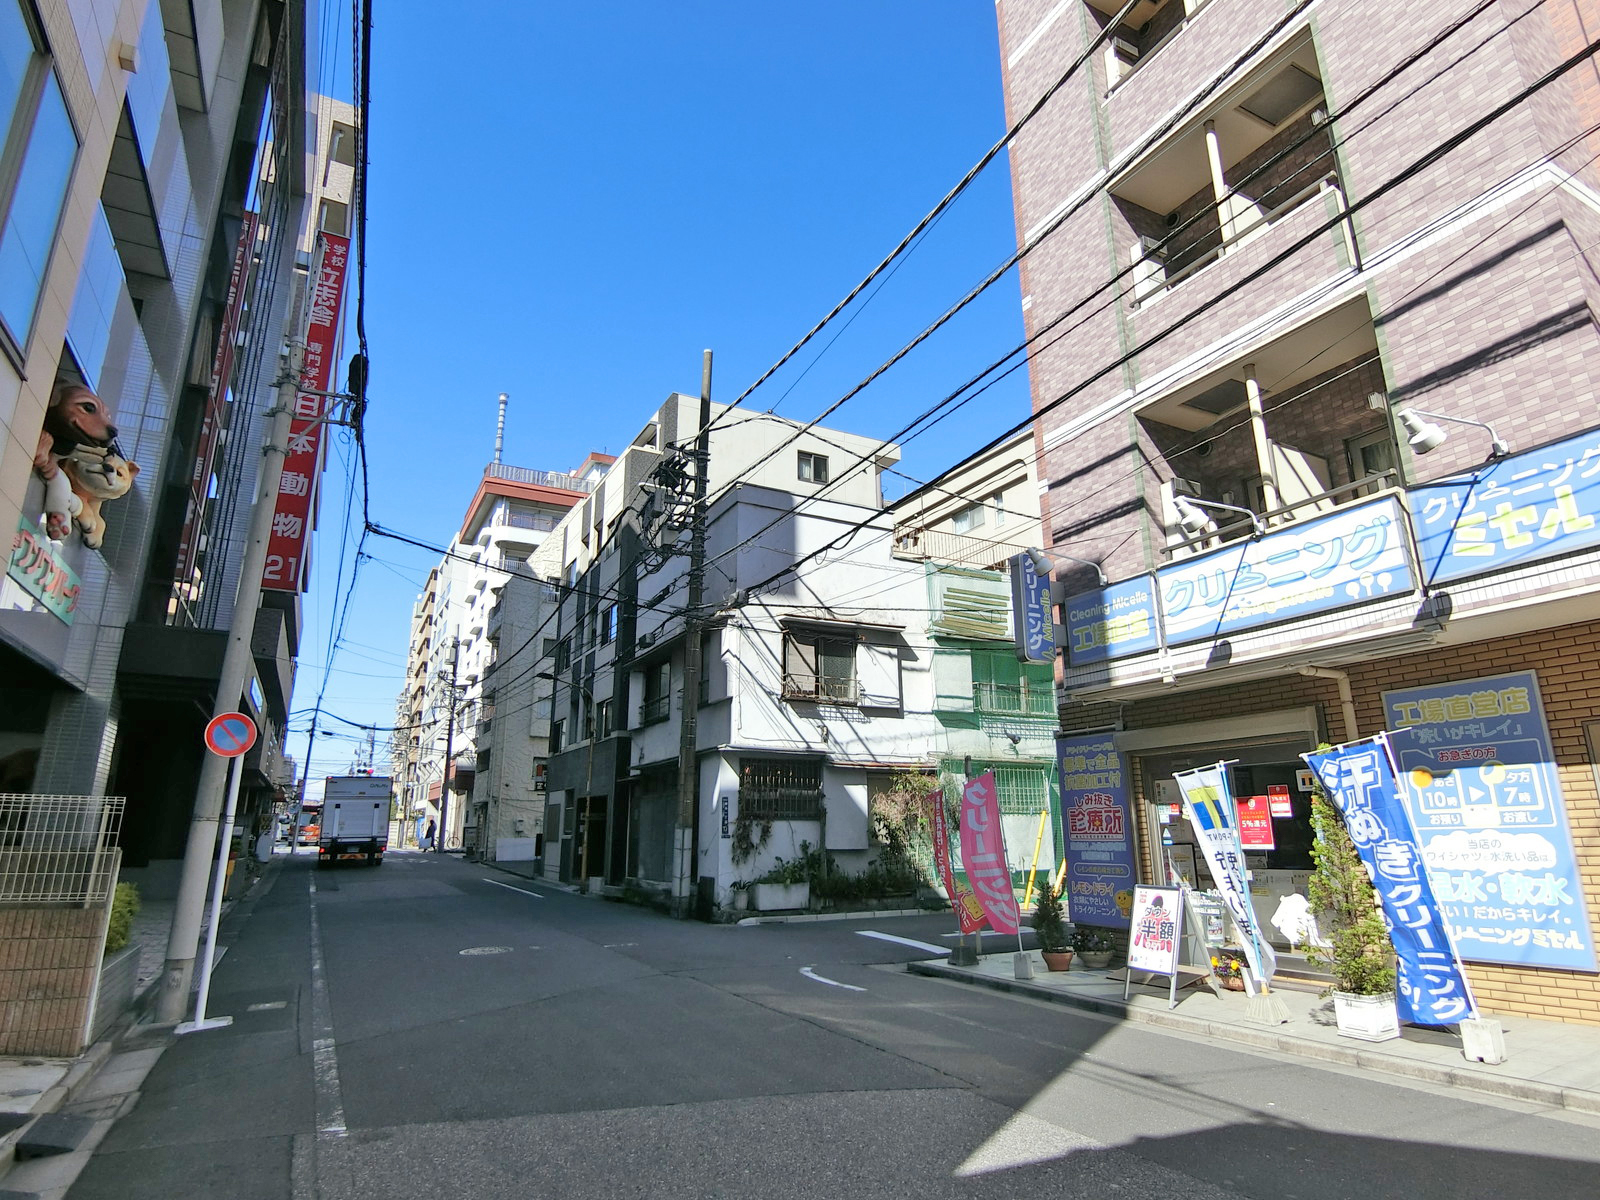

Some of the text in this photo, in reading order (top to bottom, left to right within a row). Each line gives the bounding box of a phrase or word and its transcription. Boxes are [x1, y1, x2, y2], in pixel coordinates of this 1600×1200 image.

[1069, 602, 1111, 622] Cleaning
[1392, 686, 1531, 727] 工場直営店
[1438, 746, 1497, 763] お急ぎの方
[1074, 792, 1114, 808] しみ抜き
[1069, 808, 1124, 834] 診療所
[1467, 838, 1502, 850] 当店の
[1072, 881, 1115, 898] レモンドライ
[1144, 906, 1172, 919] ダウン
[1141, 919, 1175, 941] 半額
